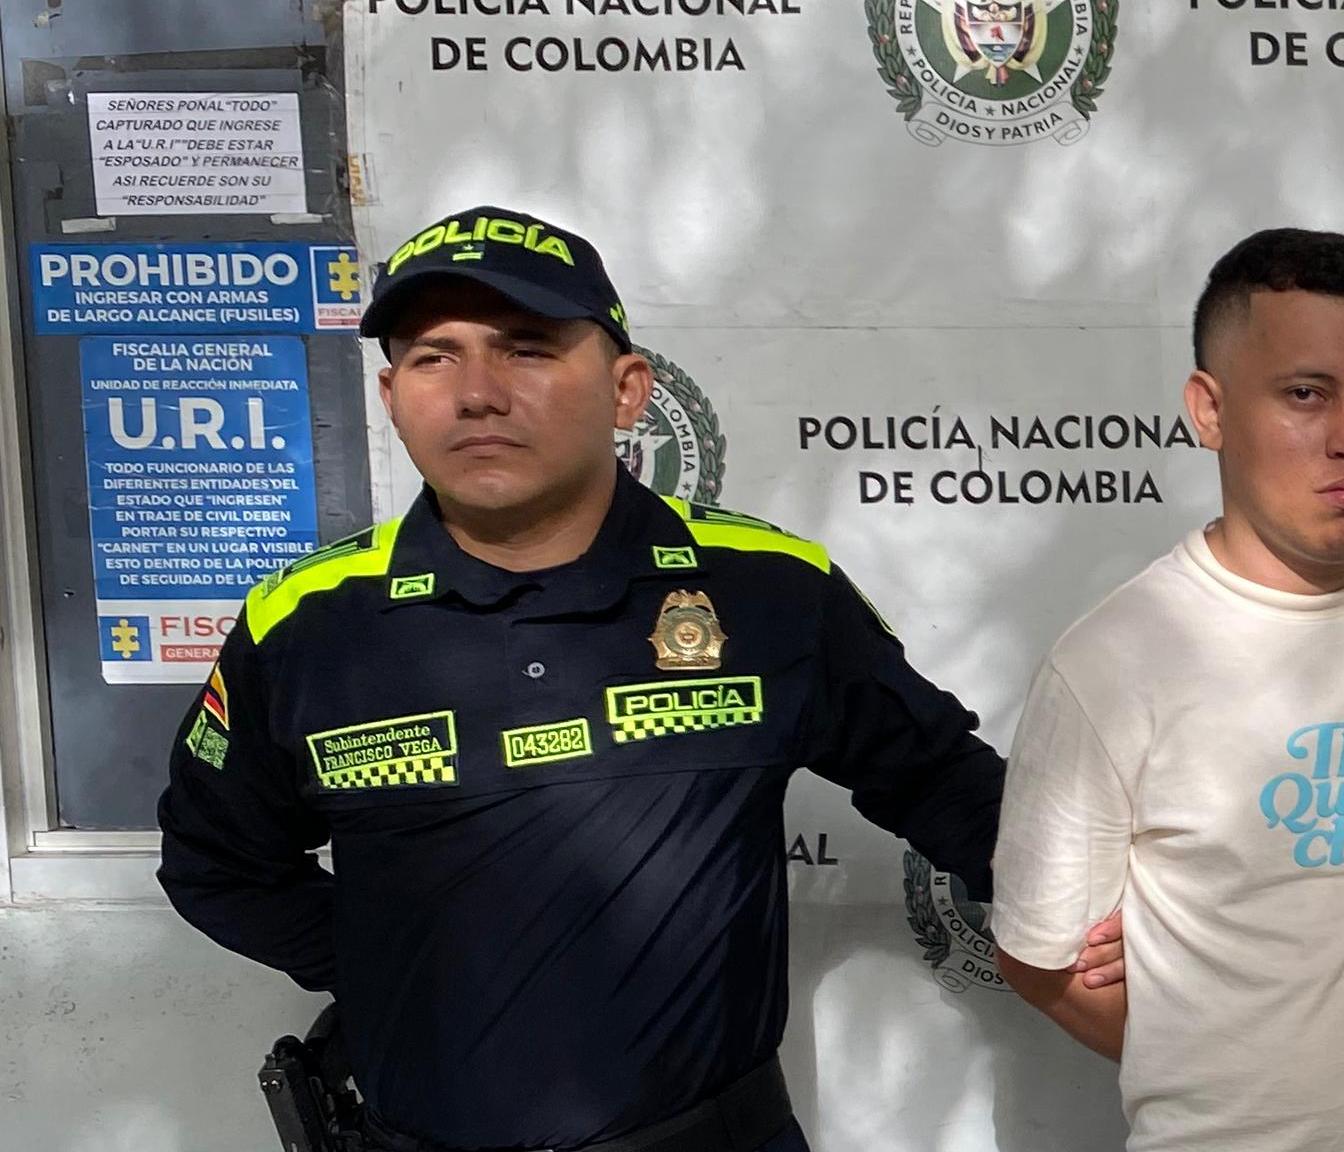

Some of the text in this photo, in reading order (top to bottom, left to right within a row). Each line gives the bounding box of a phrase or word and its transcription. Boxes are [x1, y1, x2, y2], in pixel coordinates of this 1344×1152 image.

[431, 37, 746, 72] DE COLOMBIA
[1249, 31, 1309, 66] DE
[1002, 58, 1080, 116] NACIONAL
[108, 98, 174, 111] SEÑORES
[96, 120, 282, 131] CAPTURADO QUE INGRESE
[936, 112, 1063, 140] DIOS PATRIA
[103, 140, 274, 150] A ESTAR
[192, 157, 200, 167] Y
[203, 156, 299, 168] PERMANECER
[112, 175, 271, 186] ASI RECUERDE SON SU
[387, 217, 575, 276] POLICÍA
[40, 253, 298, 287] PROHIBIDO
[76, 291, 269, 304] INGRESAR CON ARMAS
[47, 308, 300, 323] DE LARGO ALCANCE (FUSILES)
[112, 343, 272, 356] FISCALIA GENERAL
[133, 356, 252, 371] DE LA NACIÓN
[91, 378, 298, 390] UNIDAD DE REACCIÓN INMEDIATA
[108, 397, 286, 450] U.R.I.
[798, 405, 971, 452] POLICÍA
[106, 463, 294, 474] TODO FUNCIONARIO DE LAS
[103, 479, 299, 490] DIFERENTES ENTIDADES DEL
[858, 468, 1163, 505] DE COLOMBIA
[117, 495, 172, 506] ESTADO
[174, 495, 204, 507] QUE
[115, 511, 291, 522] EN TRAJE DE CIVIL DEBEN
[122, 527, 287, 538] PORTAR SU RESPECTIVO
[167, 543, 187, 554] EN
[189, 543, 209, 554] UN
[212, 543, 258, 554] LUGAR
[261, 543, 314, 554] VISIBLE
[106, 559, 244, 570] ESTO DENTRO DE LA
[120, 575, 255, 586] DE SEGUIDAD DE LA
[625, 685, 745, 715] POLICÍA
[323, 725, 431, 755] Subintendente
[512, 727, 584, 759] 043282
[323, 737, 442, 772] FRANCISCO VEGA
